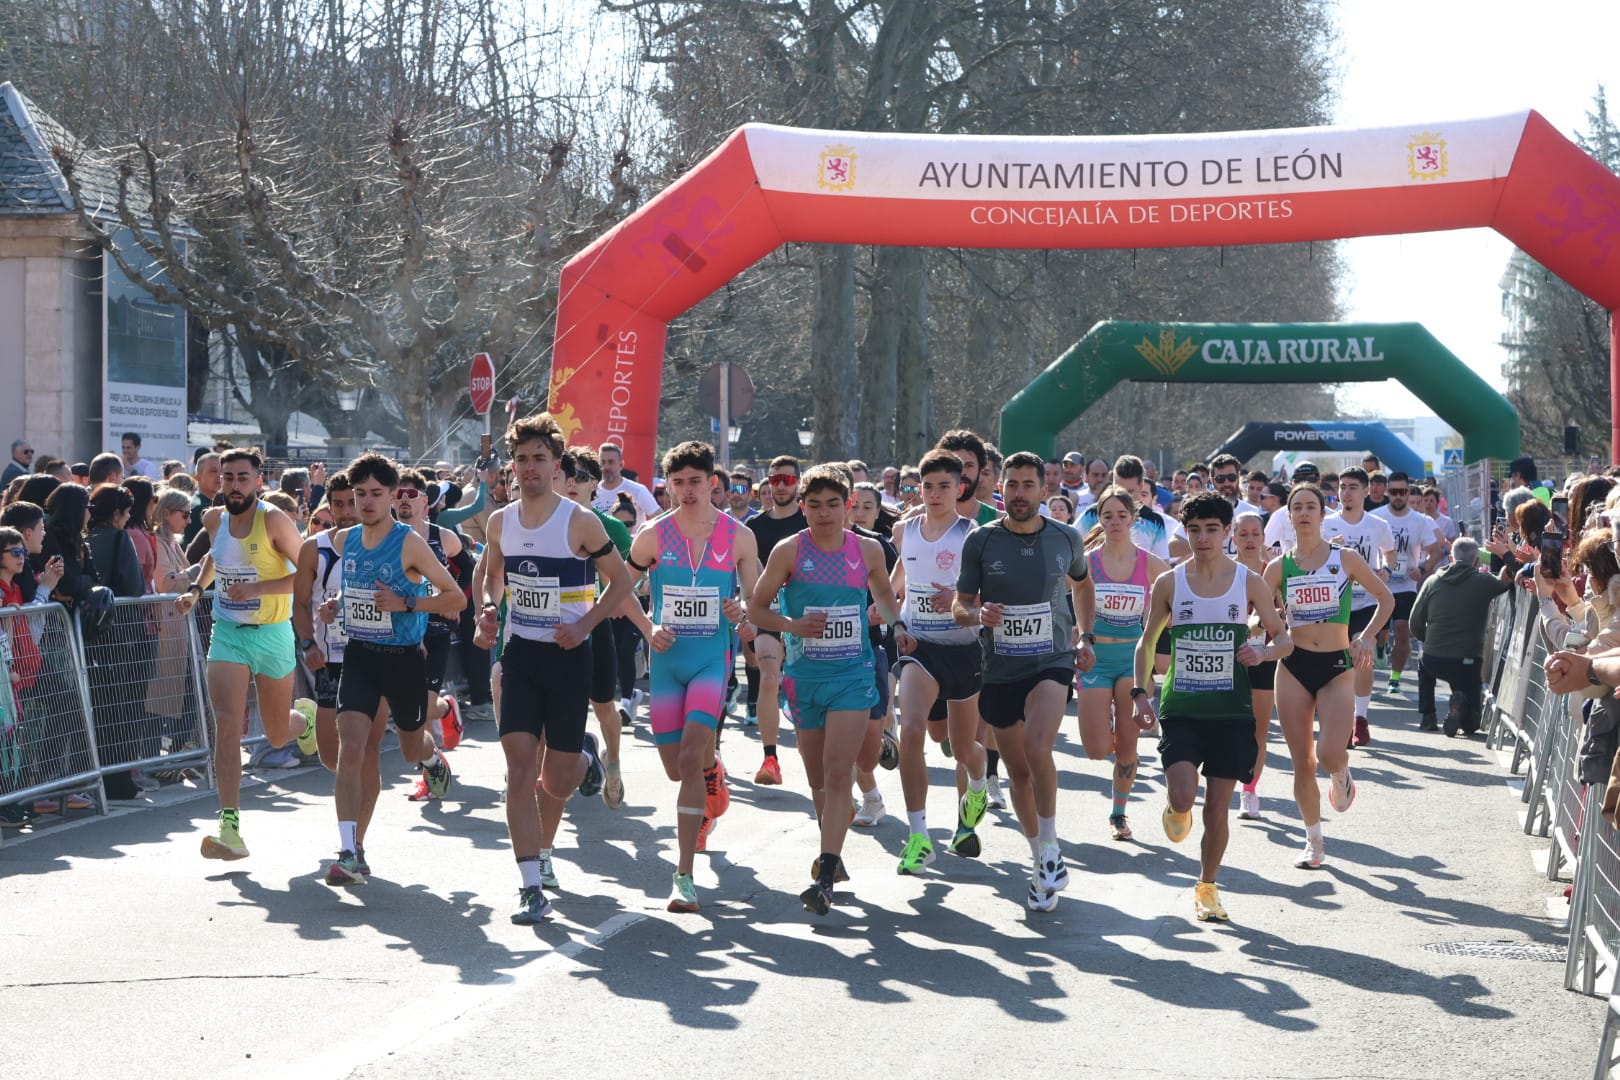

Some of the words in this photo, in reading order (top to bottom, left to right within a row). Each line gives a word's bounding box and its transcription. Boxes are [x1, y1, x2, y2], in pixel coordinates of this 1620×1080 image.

[919, 161, 1188, 189] AYUNTAMIENTO
[1202, 158, 1243, 185] DE
[1256, 148, 1343, 183] LEÓN
[970, 202, 1119, 227] CONCEJALÍA
[1128, 205, 1160, 224] DE
[1170, 199, 1293, 223] DEPORTES
[1201, 338, 1276, 365] CAJA
[1277, 336, 1385, 364] RURAL
[471, 376, 491, 391] STOP
[1274, 430, 1356, 441] POWERADE
[516, 588, 550, 609] 3607
[1104, 594, 1137, 611] 3677
[1295, 586, 1331, 605] 3809
[351, 602, 383, 622] 3535
[674, 600, 708, 617] 3510
[820, 621, 853, 639] 509
[1003, 617, 1042, 637] 3647
[1185, 654, 1225, 673] 3533
